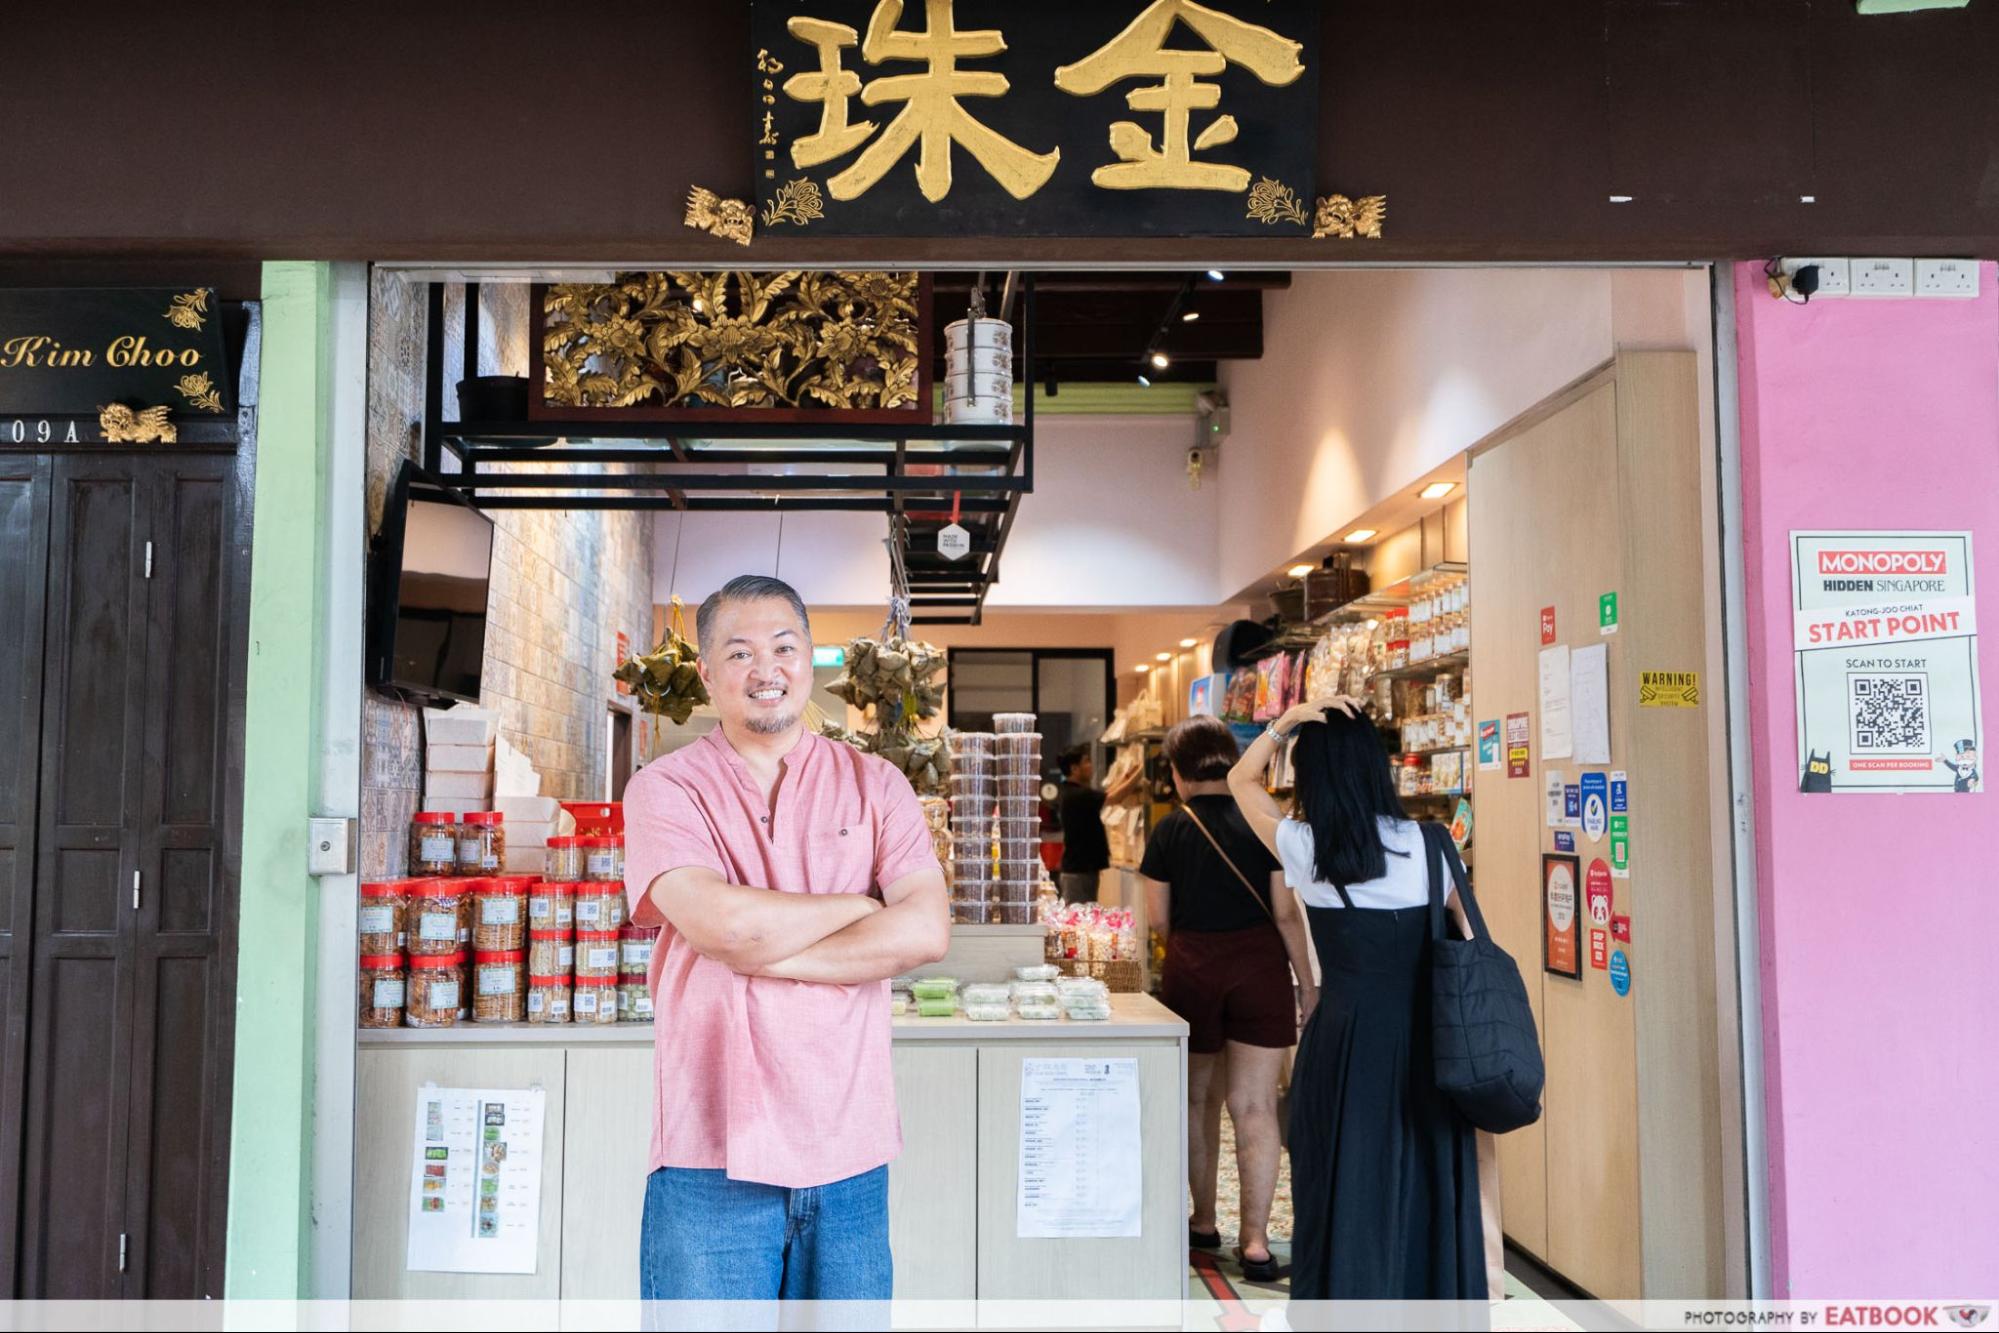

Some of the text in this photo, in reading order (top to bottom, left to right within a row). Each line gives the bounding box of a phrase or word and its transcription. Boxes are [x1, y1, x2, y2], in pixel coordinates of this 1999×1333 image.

[0, 336, 201, 367] Kim Choo
[1822, 553, 1944, 572] MONOPOLY
[1823, 579, 1946, 592] HIDDEN SINGAPORE
[1845, 604, 1923, 617] KATONG-JOO CHIAT
[1809, 611, 1960, 643] START POINT
[1846, 659, 1926, 668] SCAN TO START
[1642, 672, 1696, 686] WARNING!
